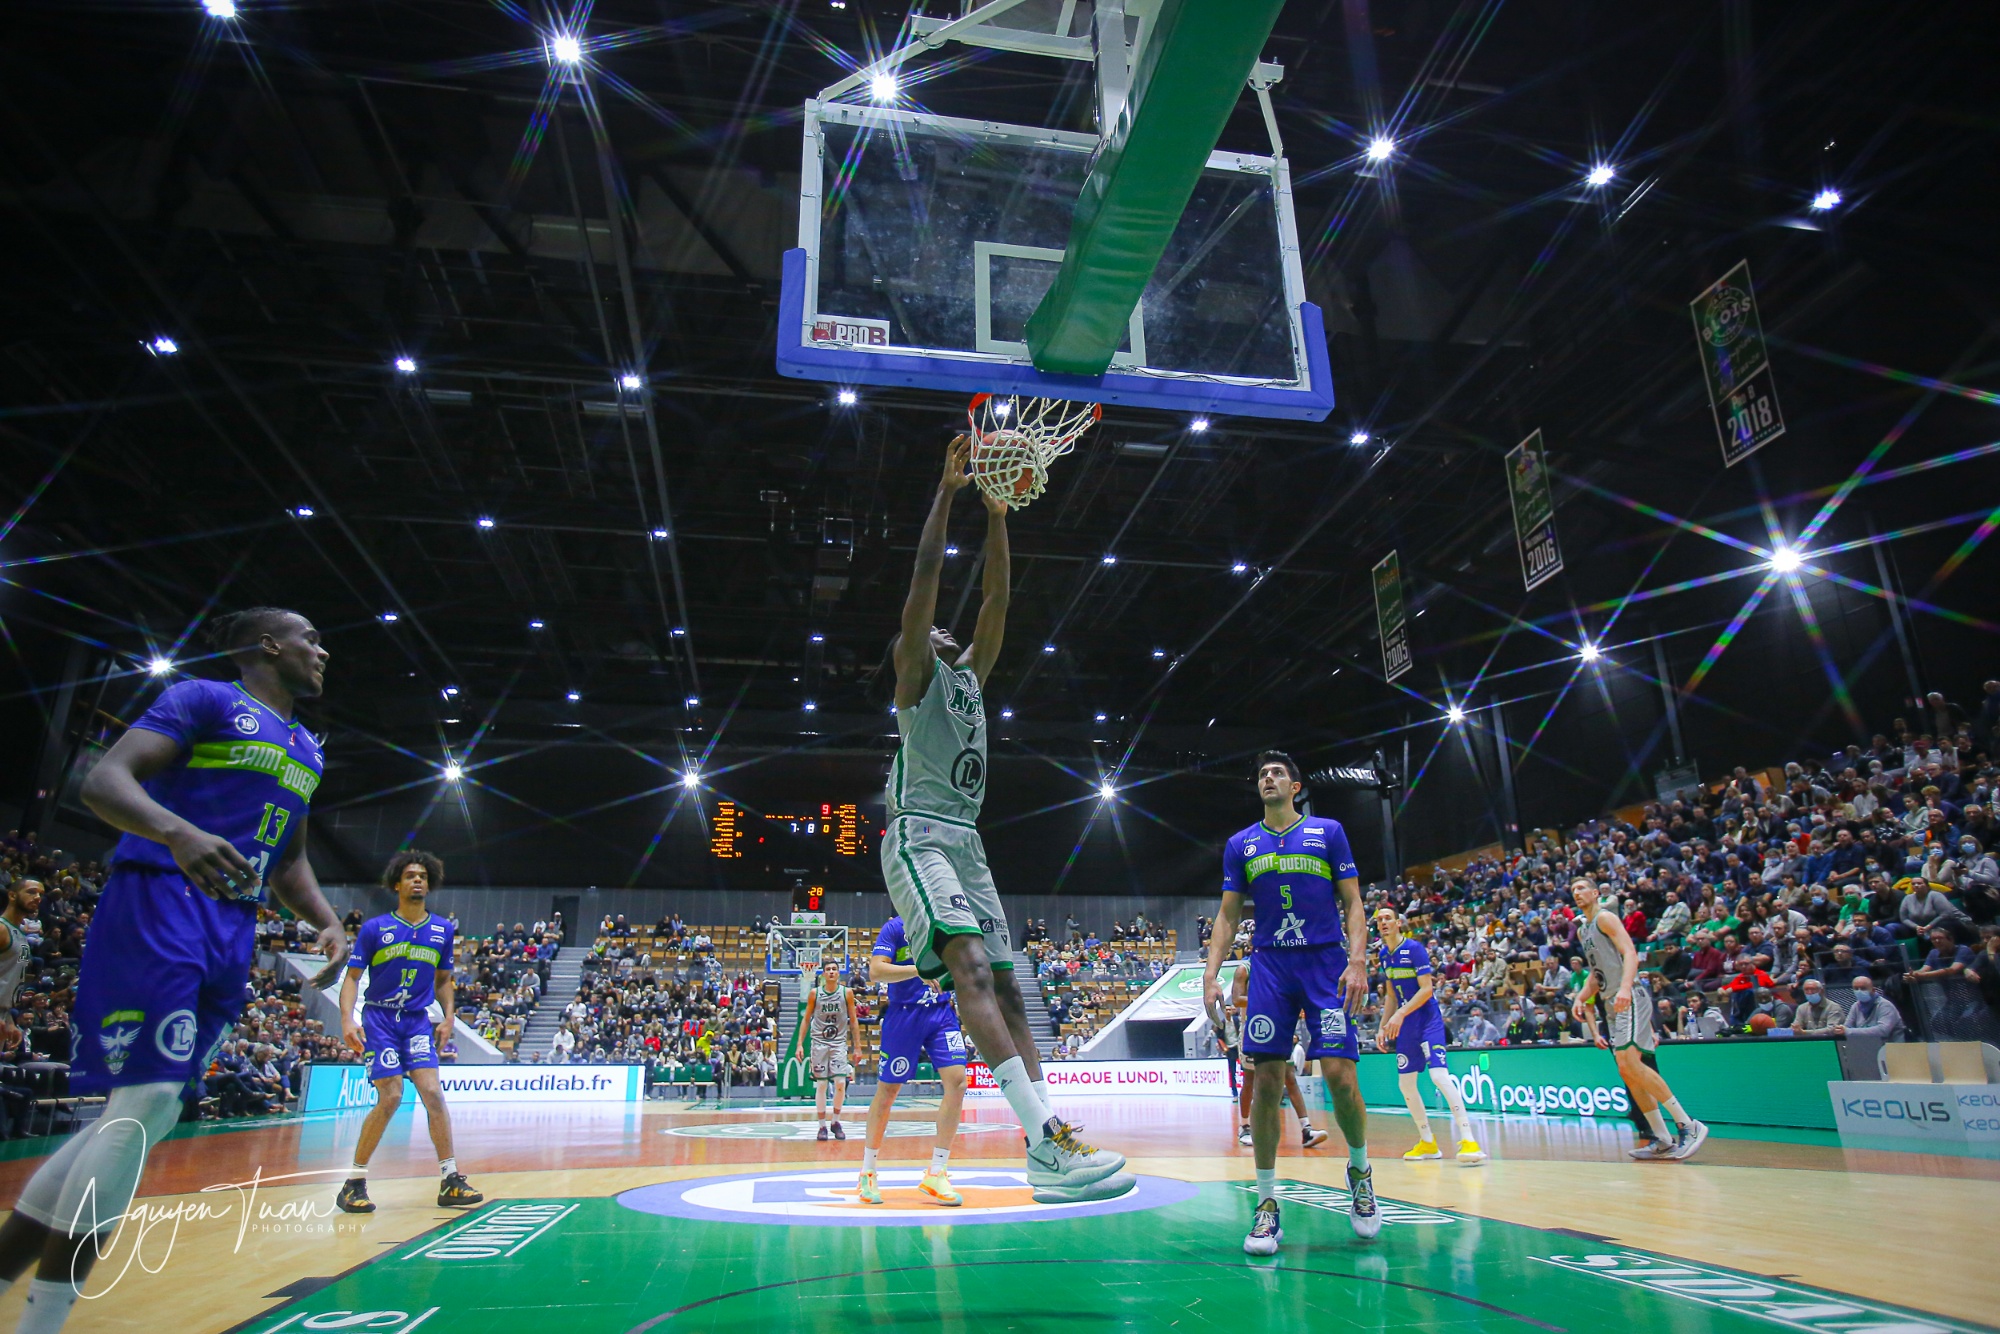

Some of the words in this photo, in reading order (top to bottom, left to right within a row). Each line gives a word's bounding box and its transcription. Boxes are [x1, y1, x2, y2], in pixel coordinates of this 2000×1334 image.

[1702, 297, 1751, 341] BLOIS
[1727, 396, 1773, 448] 2018
[1527, 538, 1556, 576] 2016
[1386, 640, 1409, 671] 2005
[254, 802, 290, 847] 13
[1280, 885, 1293, 909] 5
[1273, 939, 1308, 947] L'AISNE
[400, 968, 418, 987] 19
[821, 1003, 841, 1012] ADA
[825, 1014, 837, 1023] 45
[439, 1074, 612, 1091] www.audilab.fr
[1047, 1072, 1112, 1084] CHAQUE
[1118, 1071, 1168, 1085] LUNDI,
[1173, 1071, 1190, 1083] TOUT
[1191, 1071, 1198, 1083] LE
[1200, 1071, 1220, 1083] SPORT
[1500, 1084, 1629, 1116] paysages
